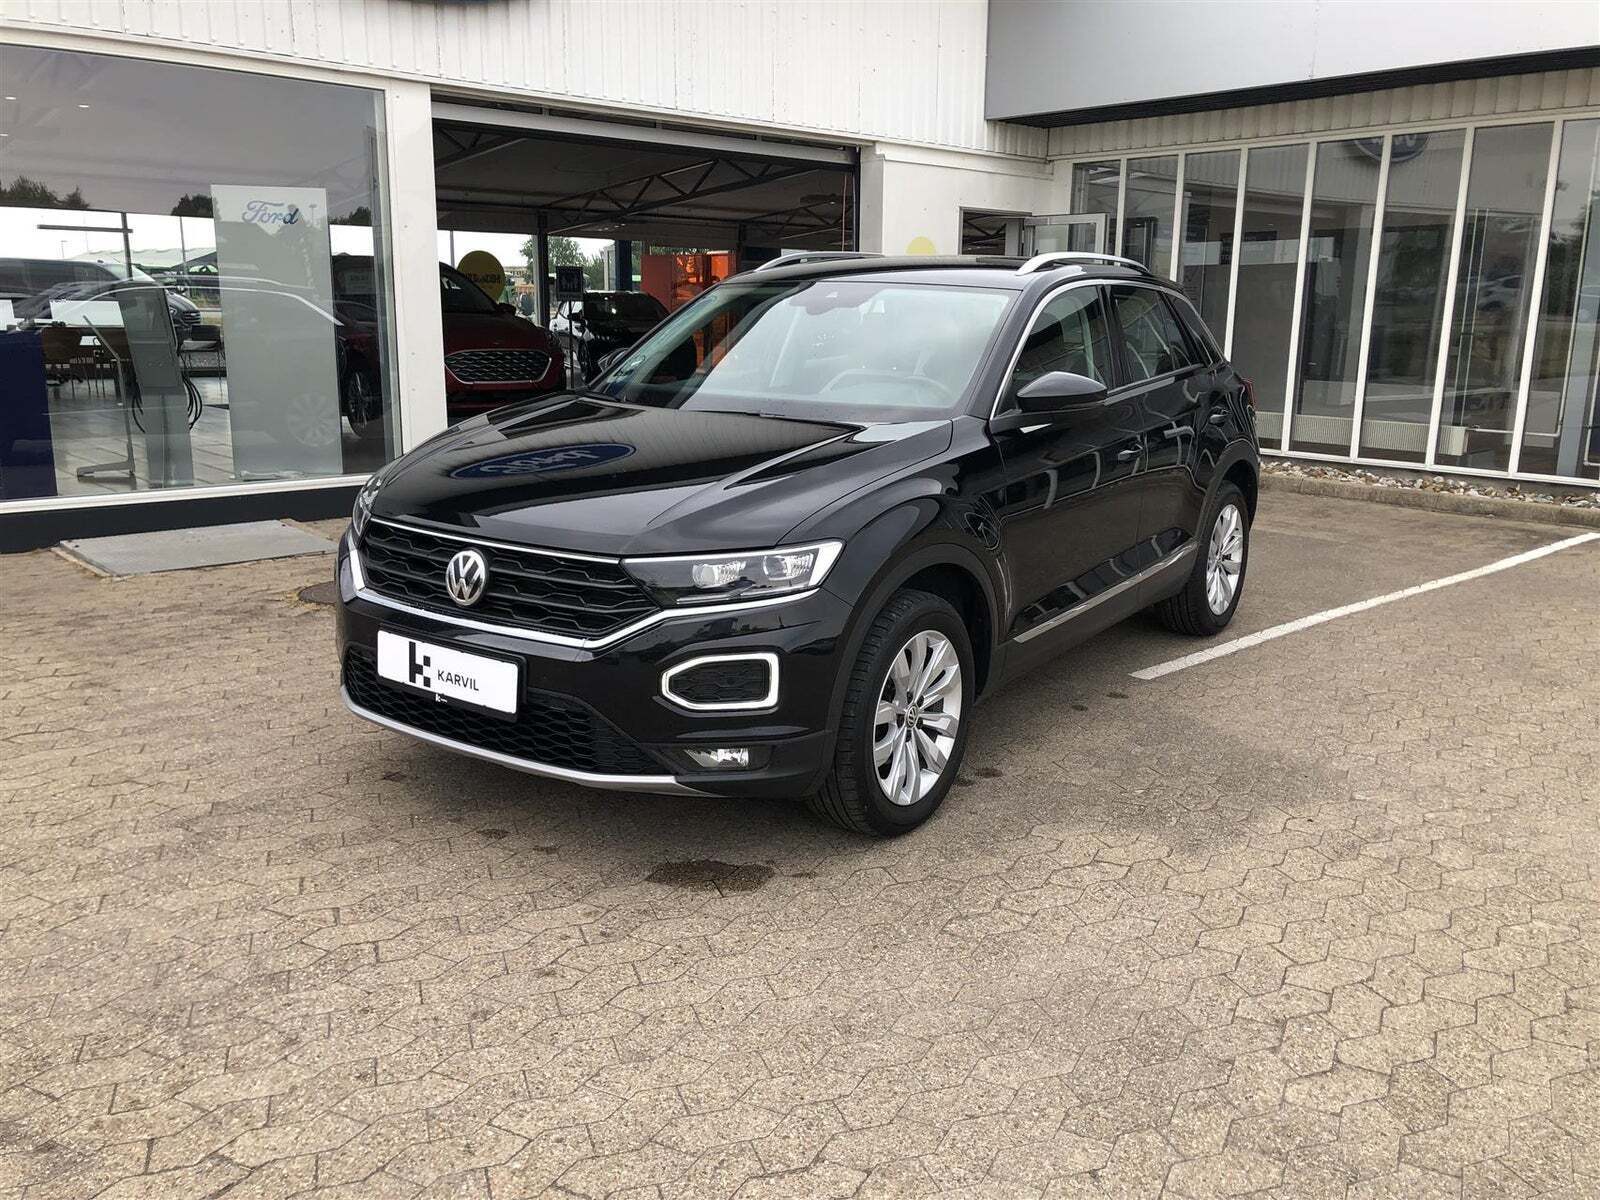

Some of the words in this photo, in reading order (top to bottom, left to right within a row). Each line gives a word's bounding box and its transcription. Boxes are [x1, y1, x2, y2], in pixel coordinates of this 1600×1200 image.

[242, 200, 299, 224] Ford
[447, 551, 485, 604] VW
[437, 669, 479, 691] KARVIL
